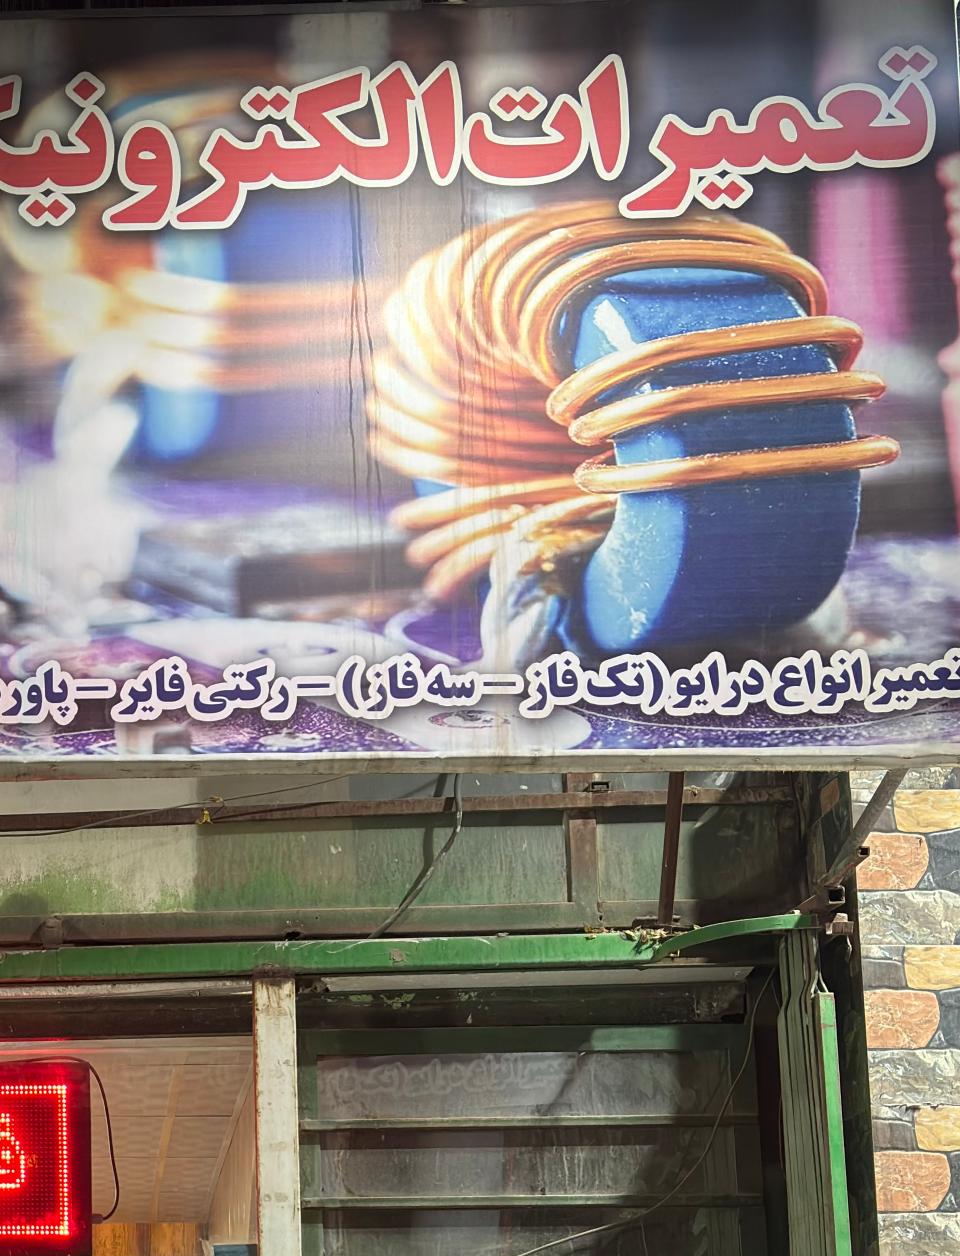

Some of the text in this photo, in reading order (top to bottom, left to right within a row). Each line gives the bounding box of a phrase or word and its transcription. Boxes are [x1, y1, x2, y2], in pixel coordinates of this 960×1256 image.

[468, 47, 936, 214] تعمیرات
[118, 658, 186, 717] فایر
[192, 665, 291, 715] رکتی
[427, 669, 475, 700] سه
[527, 657, 576, 711] فاز
[673, 659, 766, 709] درایو
[773, 655, 864, 708] انواع
